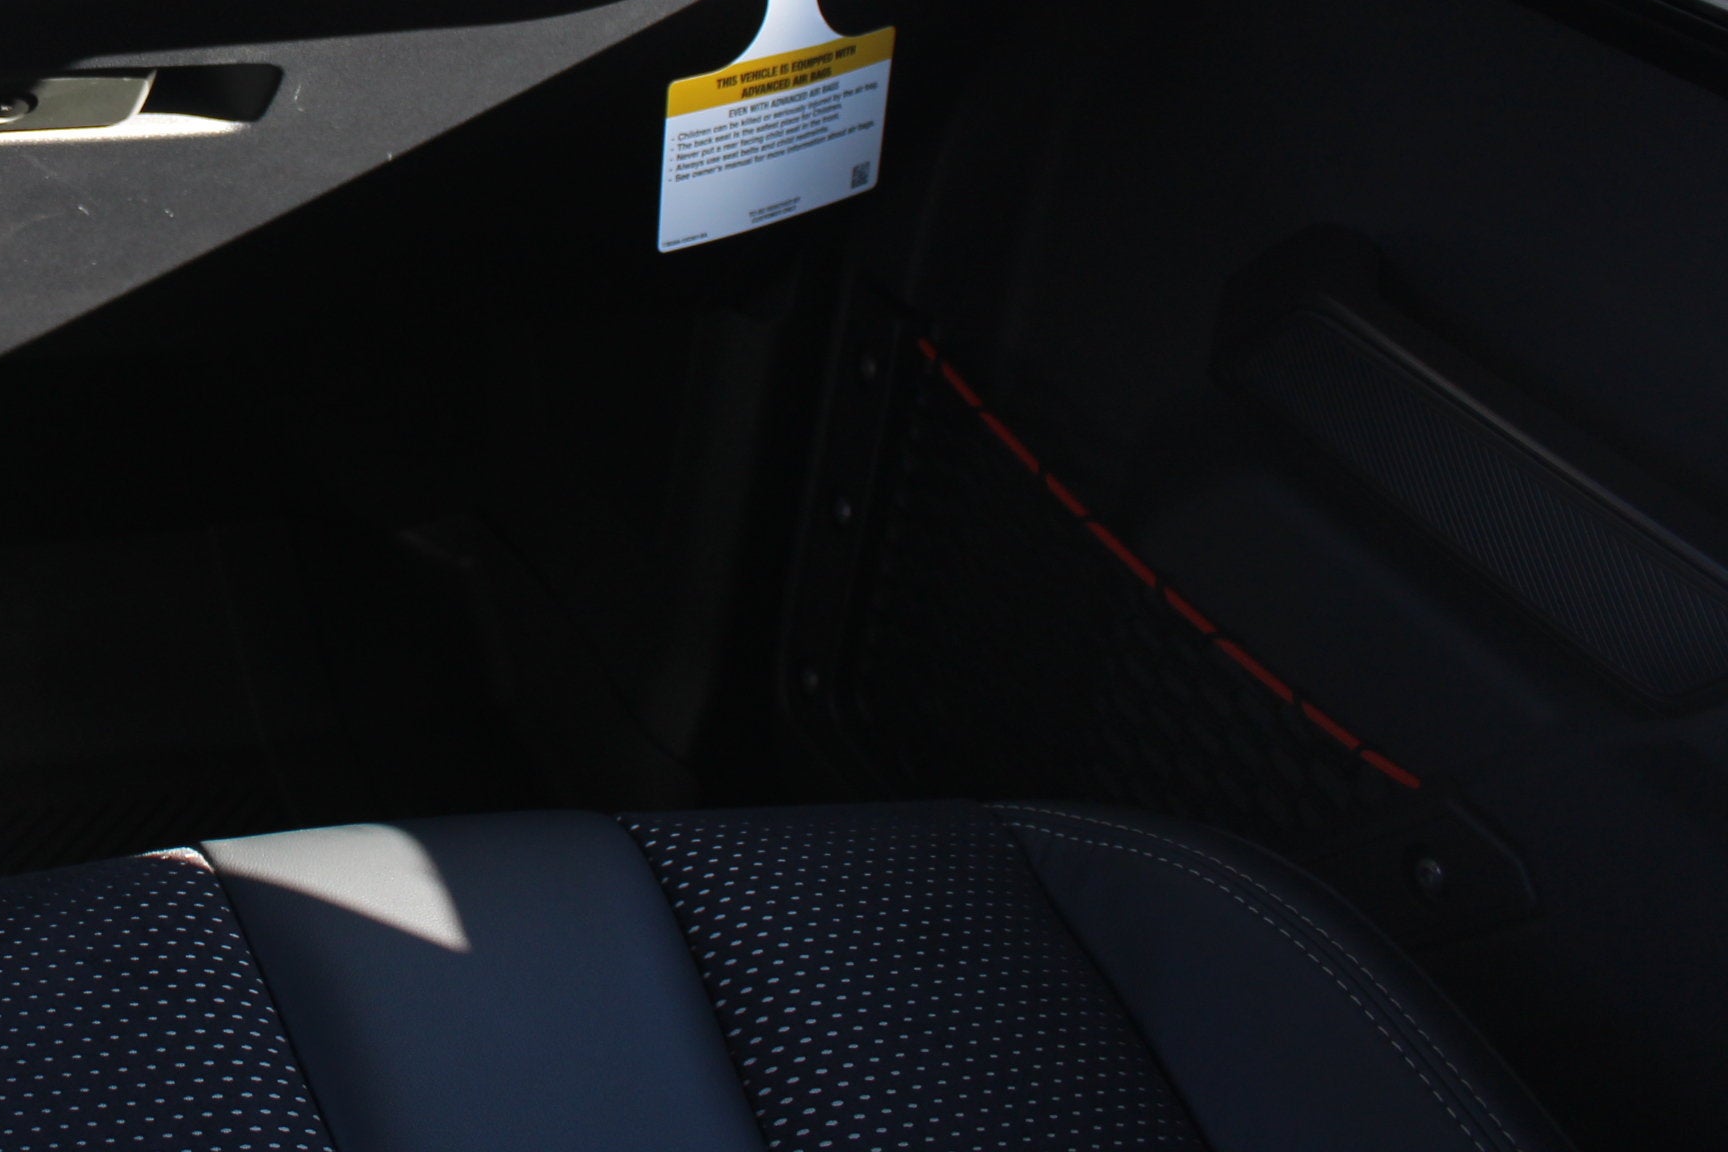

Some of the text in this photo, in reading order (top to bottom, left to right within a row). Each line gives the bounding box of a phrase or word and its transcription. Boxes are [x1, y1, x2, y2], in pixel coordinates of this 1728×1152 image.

[716, 45, 857, 89] THIS VEHICLE IS EQUIPPED WITH
[741, 77, 792, 99] ADVANCED
[792, 72, 809, 87] AIR
